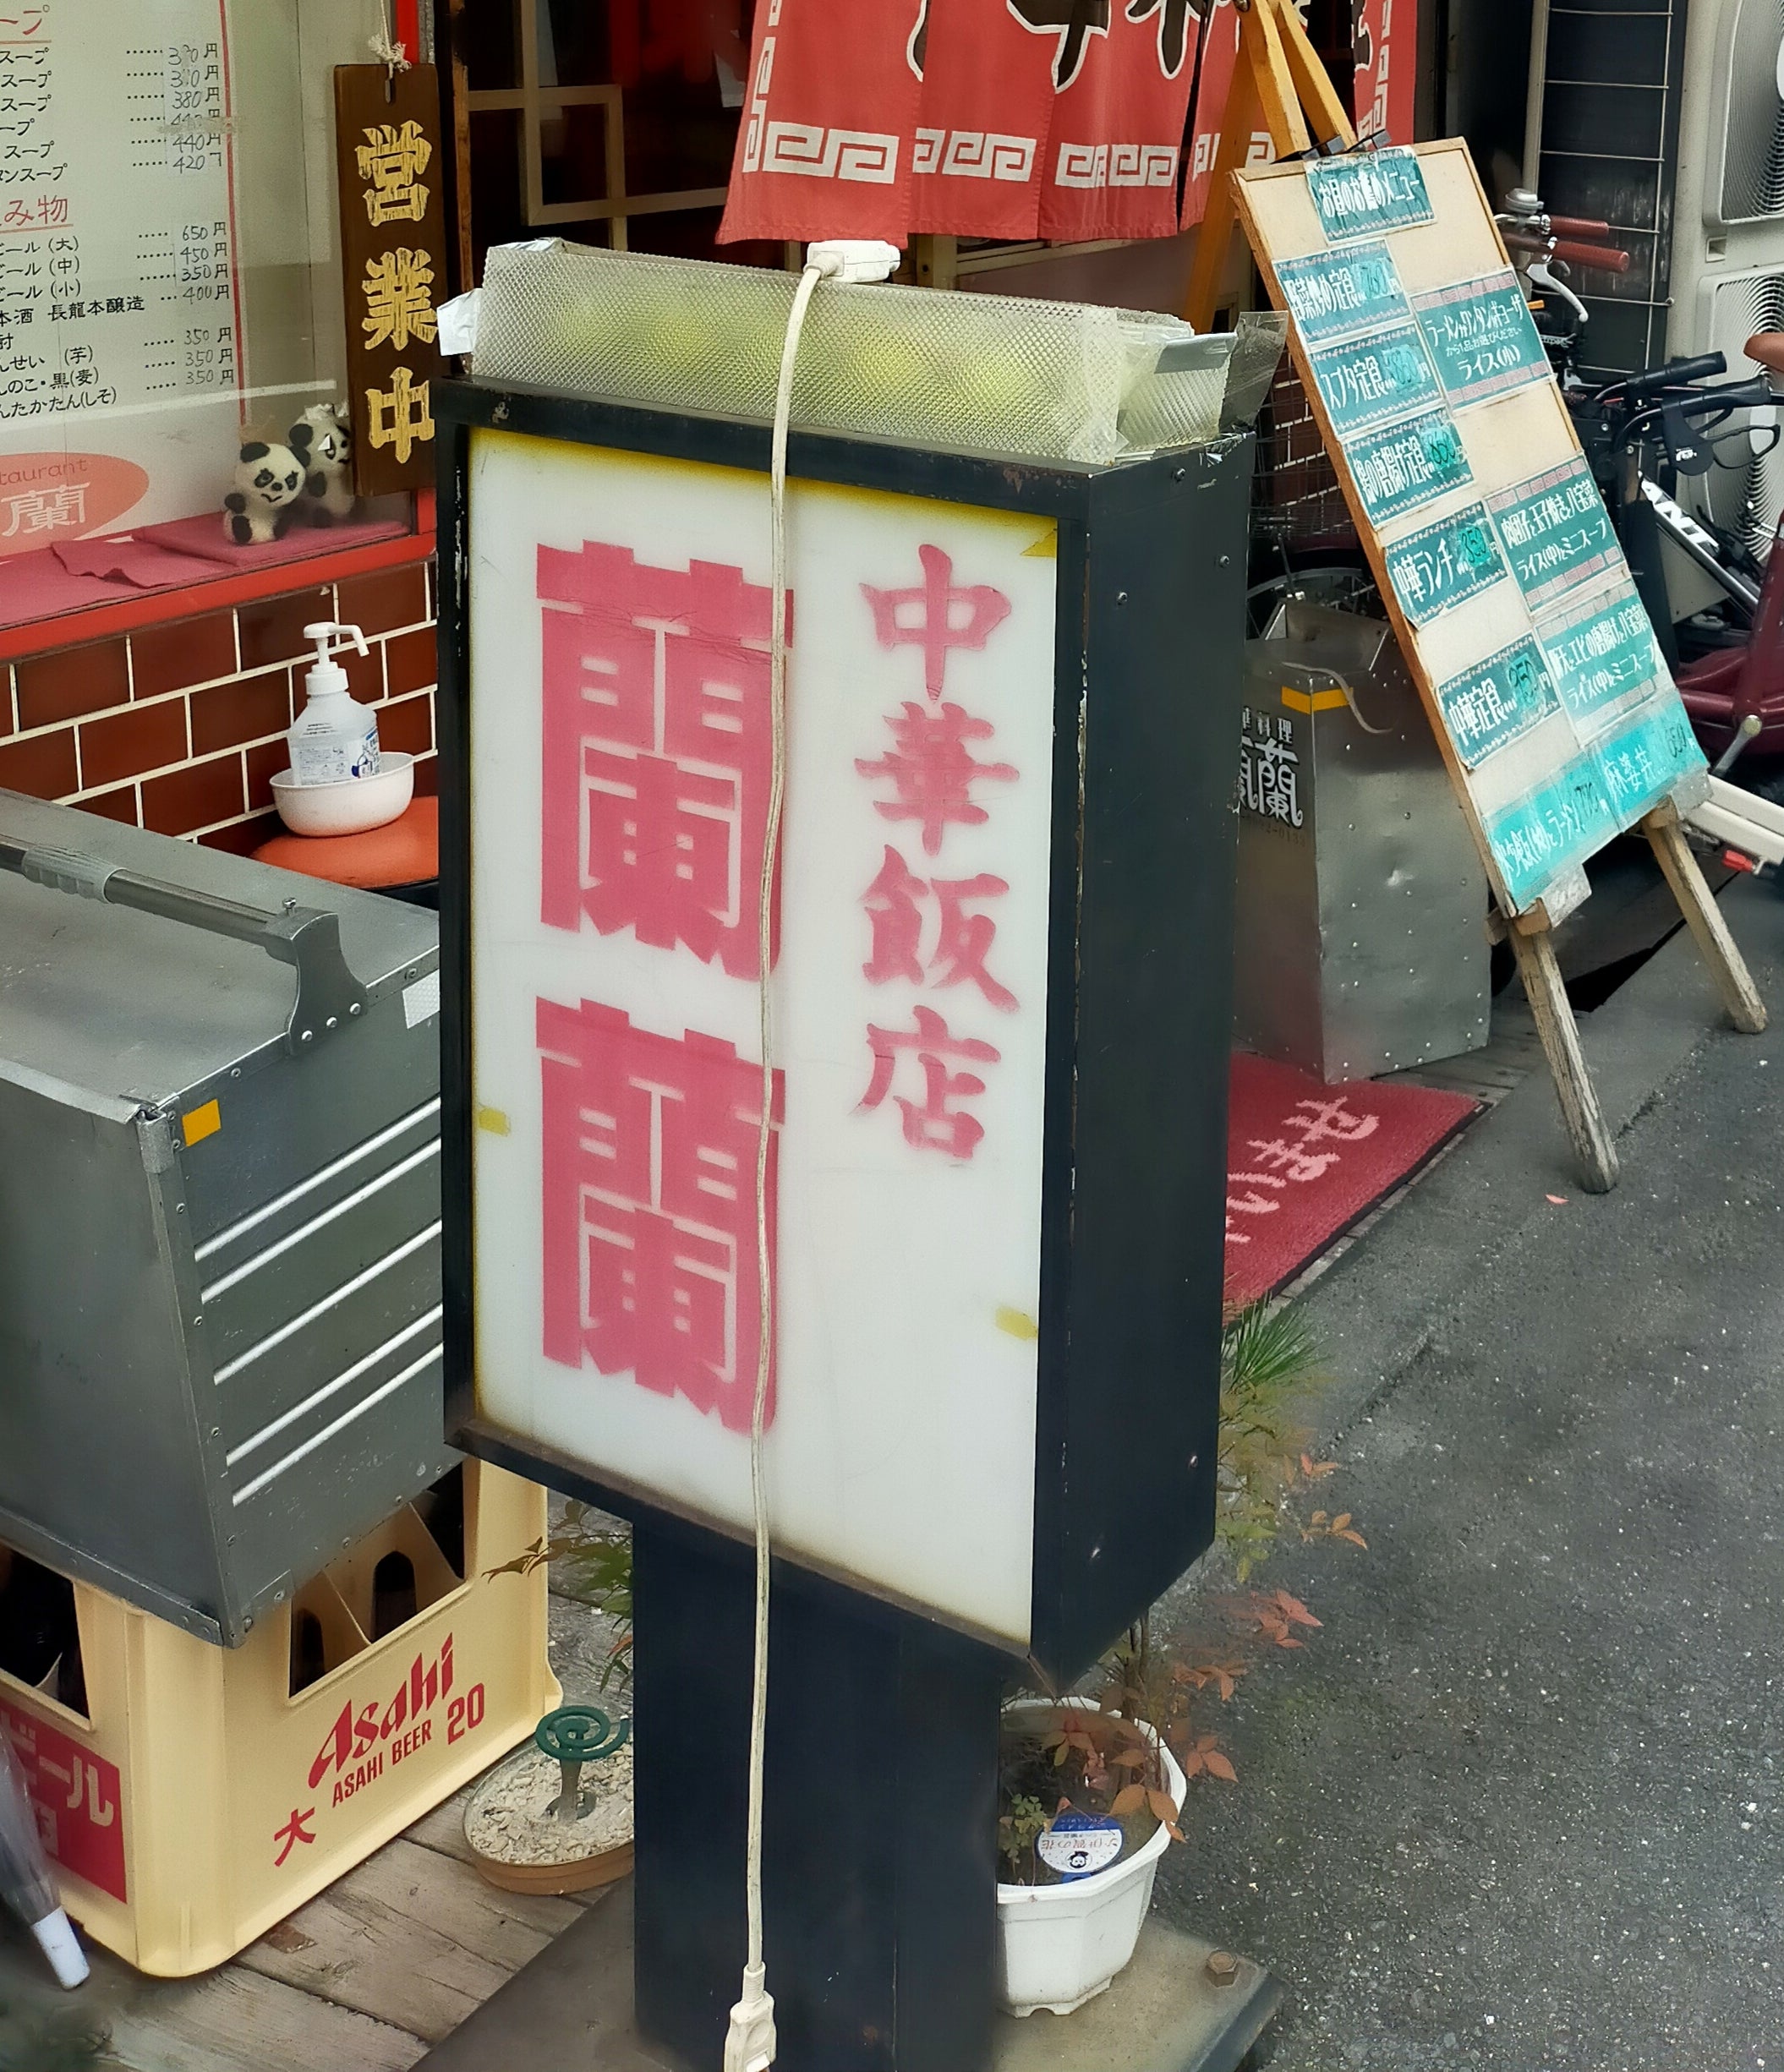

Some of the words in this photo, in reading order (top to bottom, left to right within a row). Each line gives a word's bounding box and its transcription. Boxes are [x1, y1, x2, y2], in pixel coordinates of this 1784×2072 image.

[4, 140, 55, 159] スープ
[354, 118, 438, 464] 営業中
[854, 543, 1020, 1161] 中華飯店
[536, 539, 793, 1435] 蘭蘭
[308, 1632, 453, 1789] Asahi
[332, 1752, 383, 1808] ASAHI
[391, 1719, 432, 1766] BEER
[447, 1682, 484, 1745] 20
[274, 1807, 315, 1867] 大
